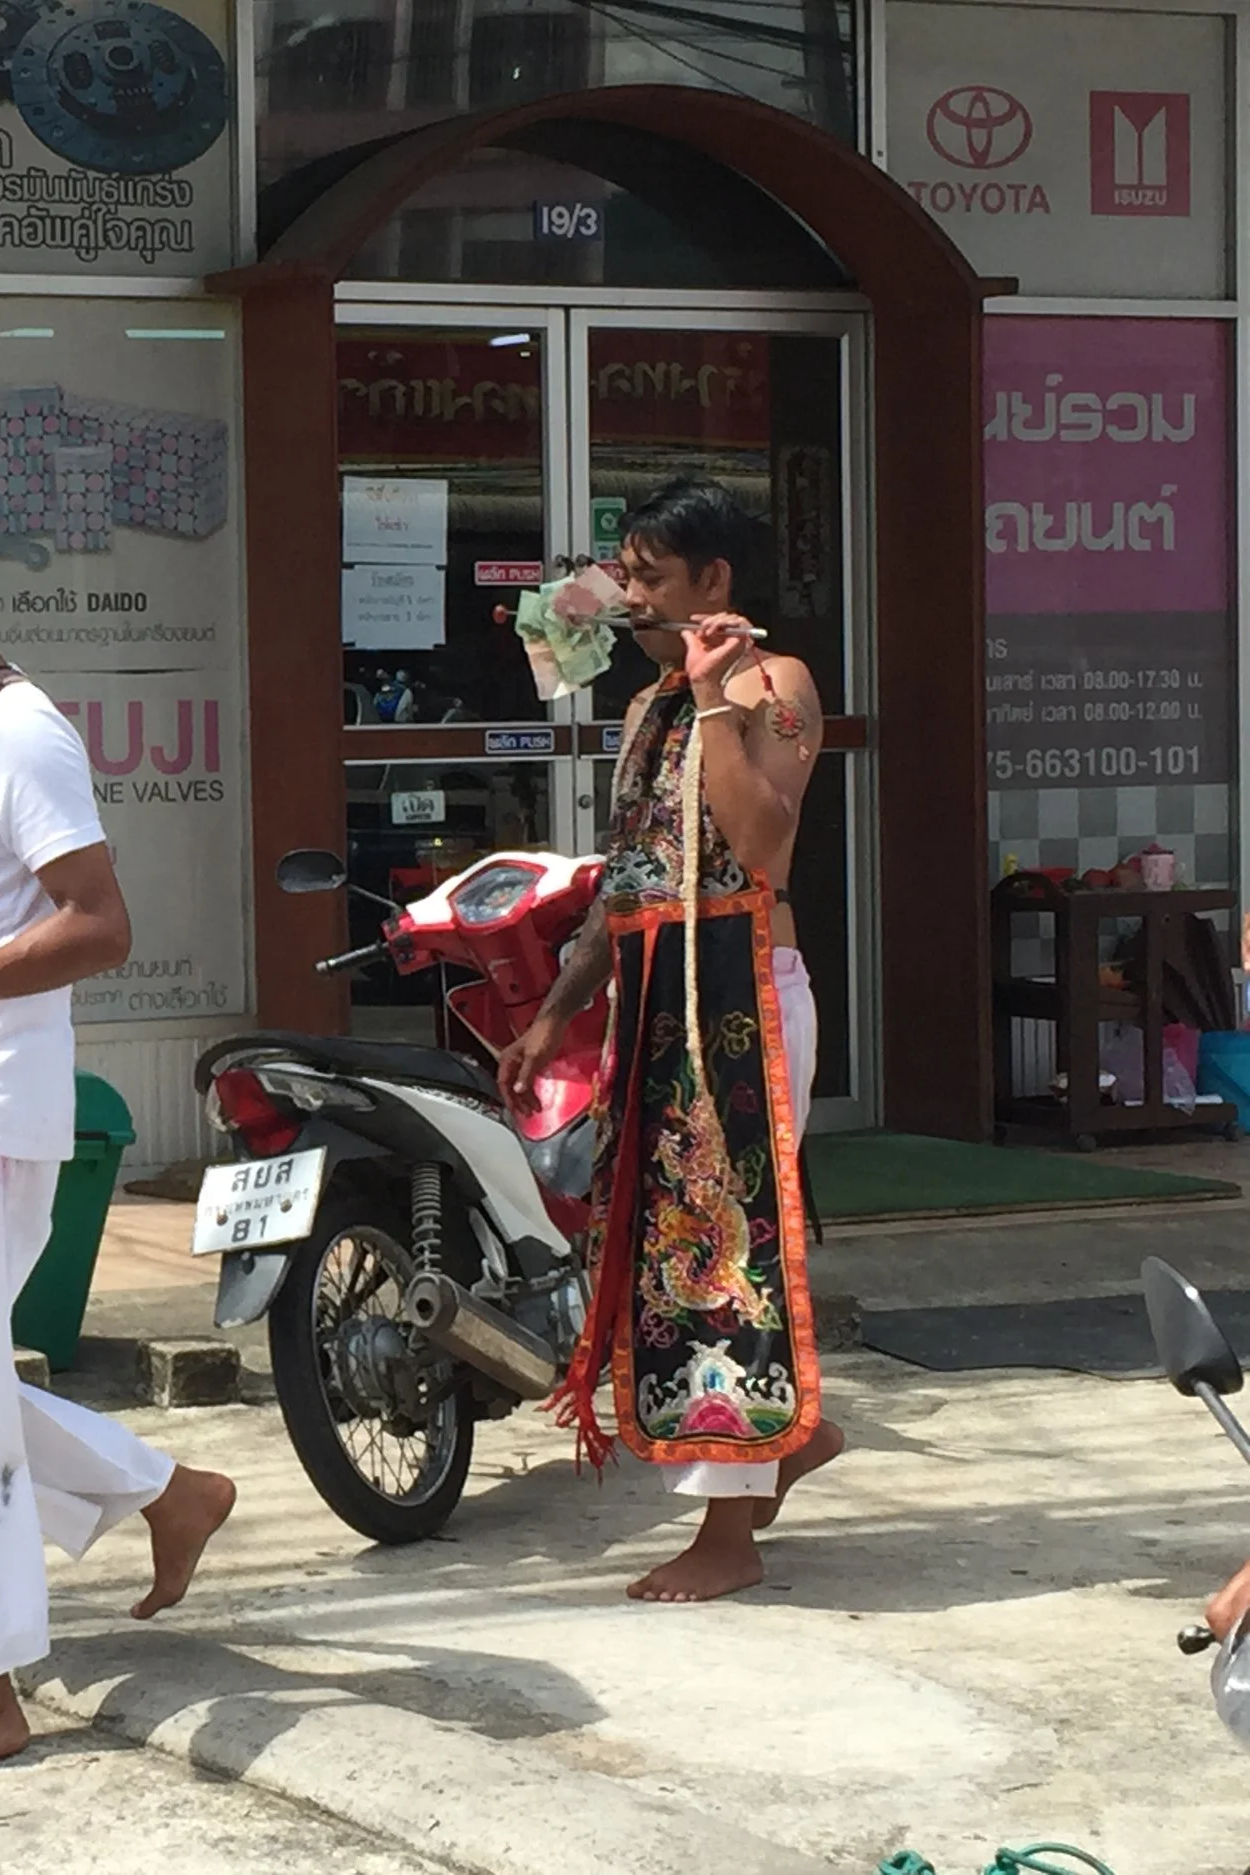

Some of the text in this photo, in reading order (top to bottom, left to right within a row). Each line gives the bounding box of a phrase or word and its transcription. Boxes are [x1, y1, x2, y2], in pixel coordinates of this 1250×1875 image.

[907, 182, 1051, 215] TOYOTA
[1113, 189, 1168, 206] ISUZU
[540, 203, 599, 239] 19/3
[87, 592, 148, 614] DAIDO
[987, 745, 1200, 780] 5-663100-101
[132, 780, 225, 803] VALVES
[230, 1158, 295, 1193] สยส
[231, 1214, 269, 1243] 81
